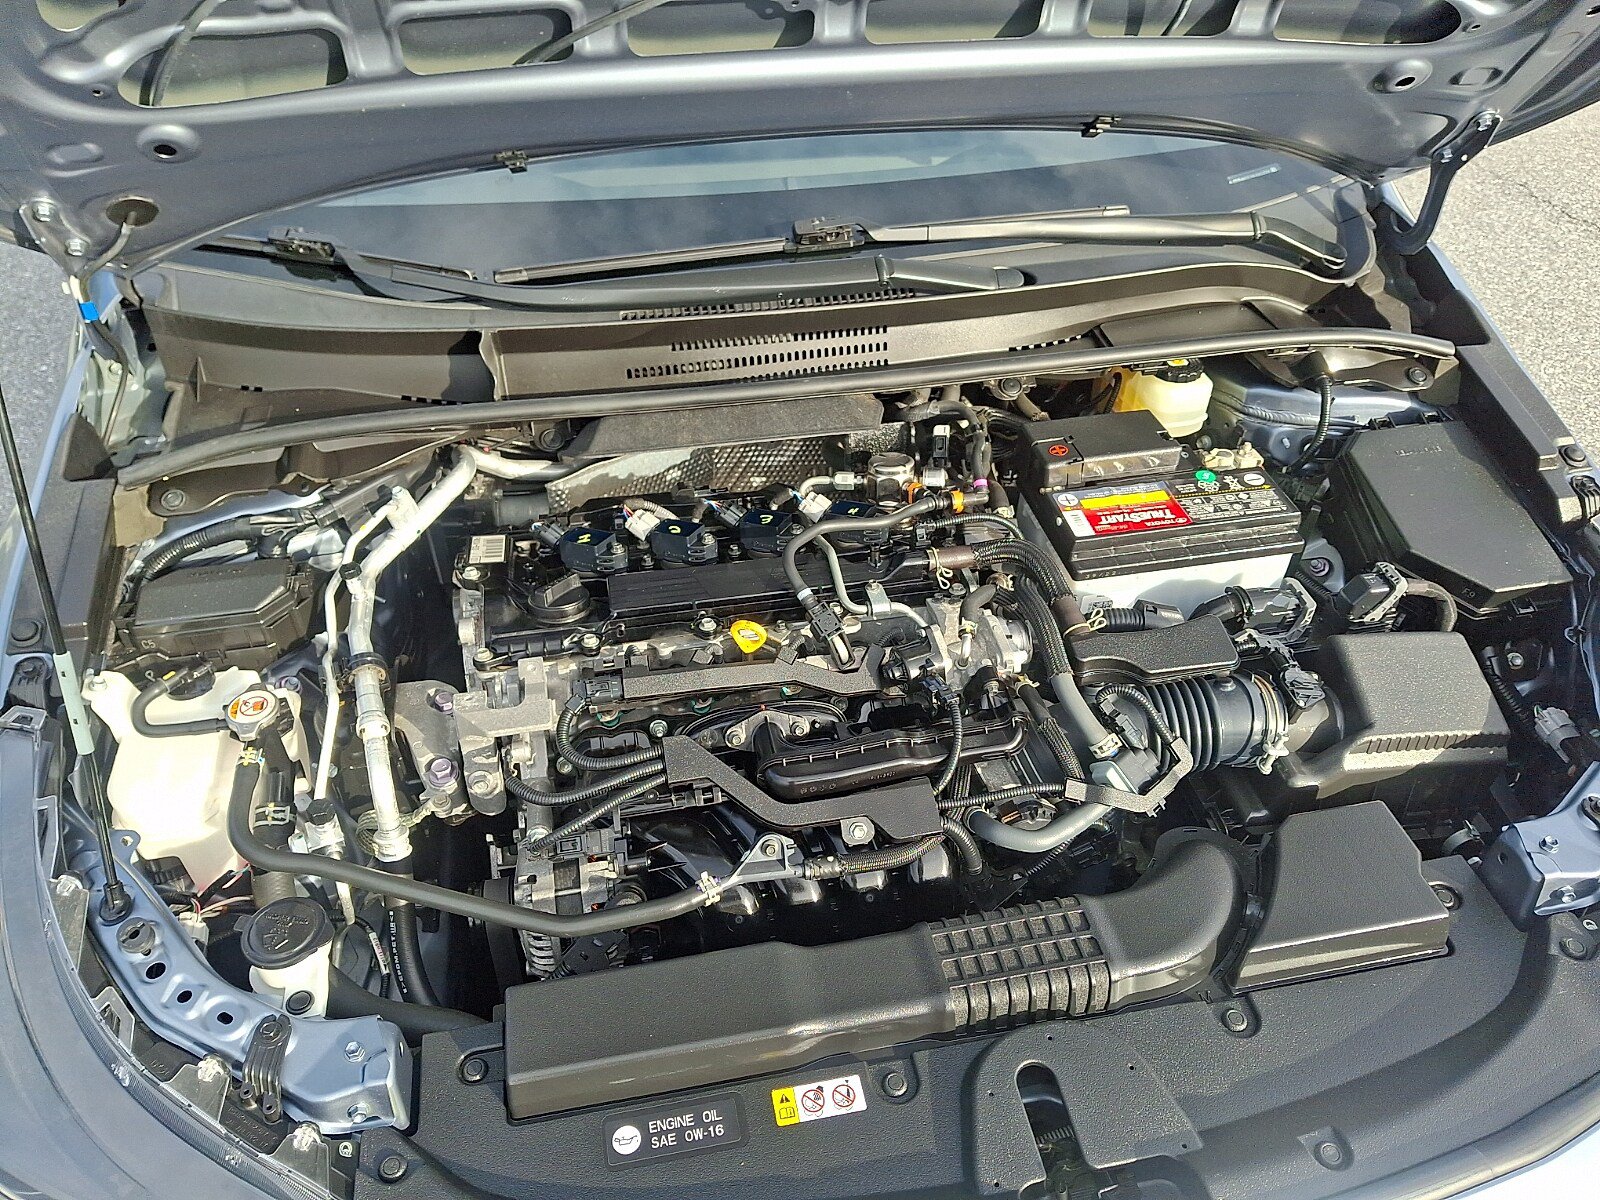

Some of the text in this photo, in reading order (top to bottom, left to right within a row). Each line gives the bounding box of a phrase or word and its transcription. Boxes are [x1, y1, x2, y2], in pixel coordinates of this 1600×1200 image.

[759, 514, 774, 525] 3
[1144, 518, 1175, 527] TOYOTA
[648, 1109, 723, 1134] ENGINE OIL
[651, 1124, 725, 1149] SAE 0W-16
